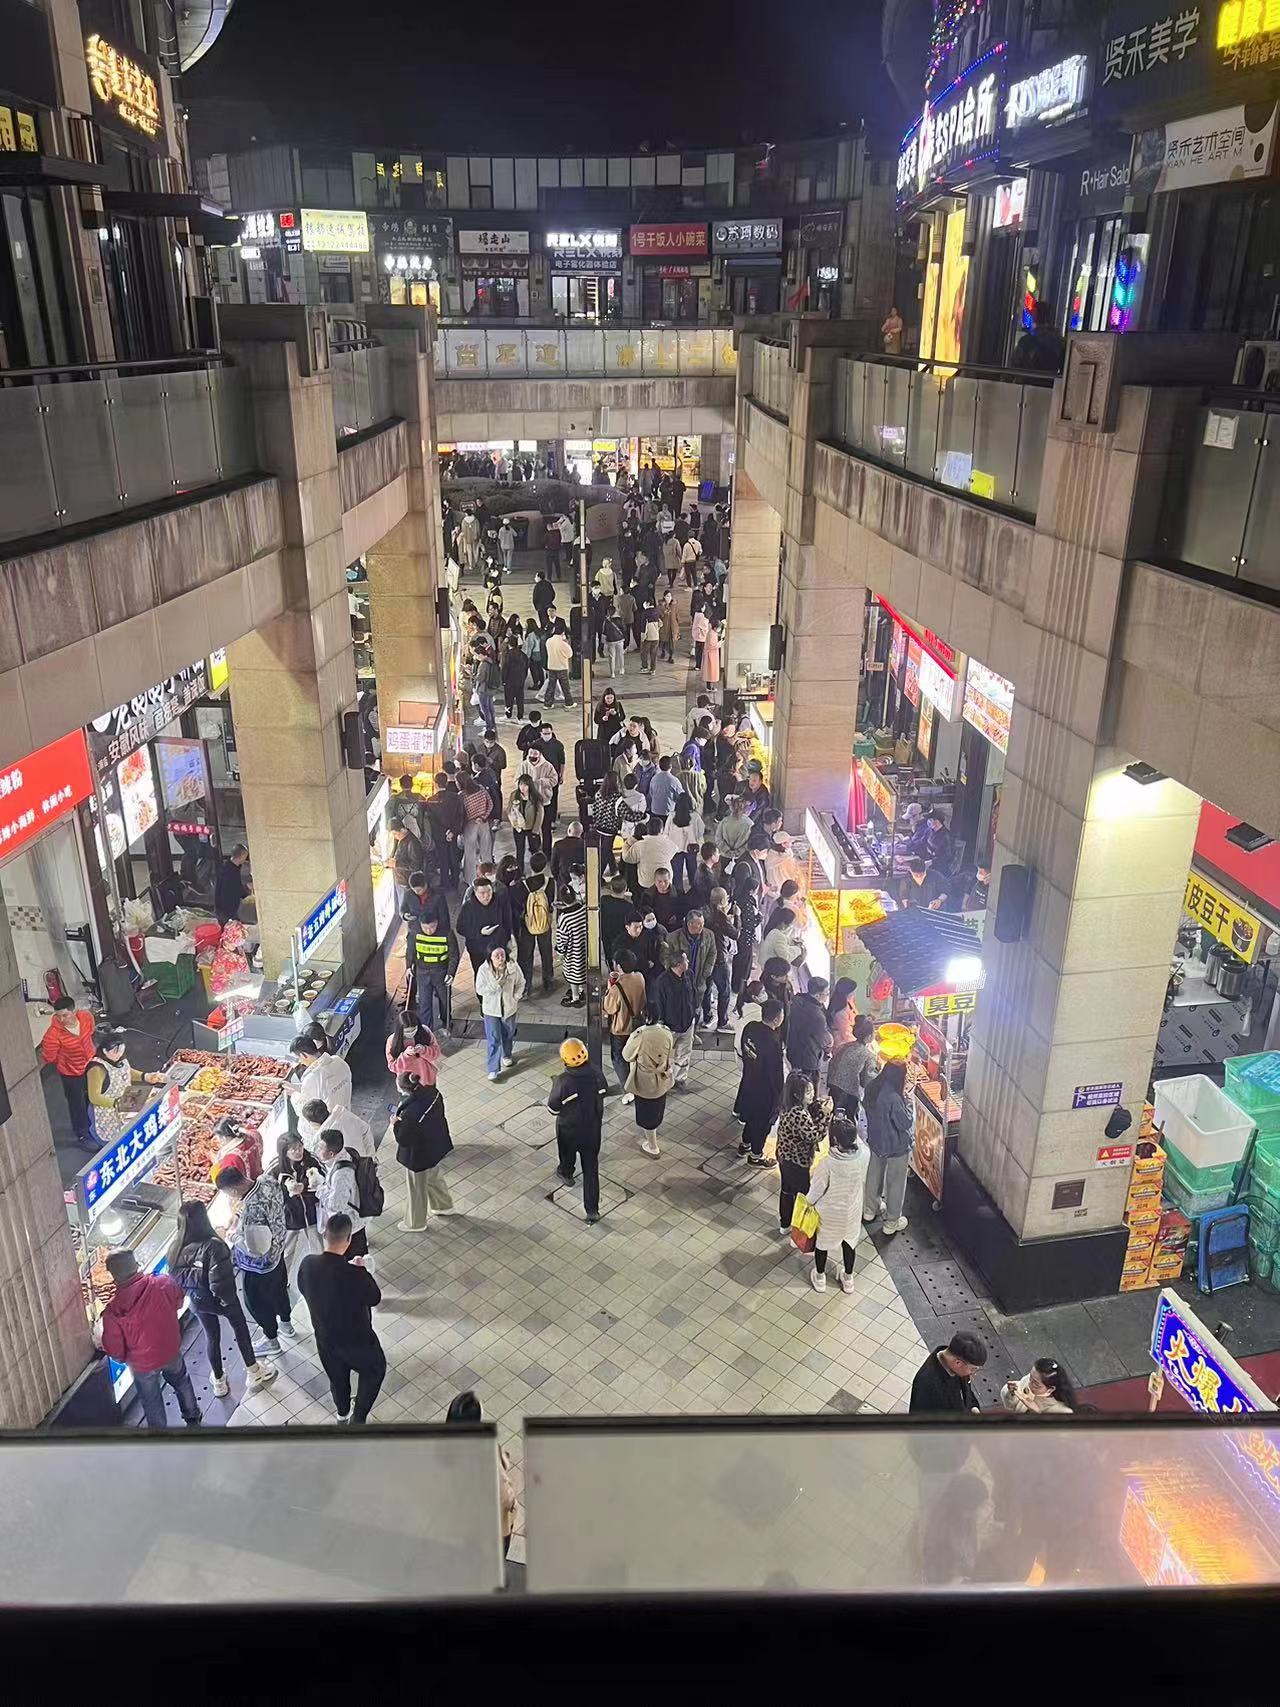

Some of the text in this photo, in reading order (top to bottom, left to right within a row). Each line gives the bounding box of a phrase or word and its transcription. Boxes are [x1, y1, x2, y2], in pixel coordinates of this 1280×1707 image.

[1102, 7, 1200, 86] 贤禾美学
[1167, 126, 1246, 160] 贤禾艺术空间
[1190, 155, 1204, 165] HE
[1208, 150, 1229, 161] ART
[632, 231, 705, 247] 1号干饭人小碗菜
[555, 260, 617, 269] 电子雾化器体验店
[1183, 878, 1230, 933] 皮豆干
